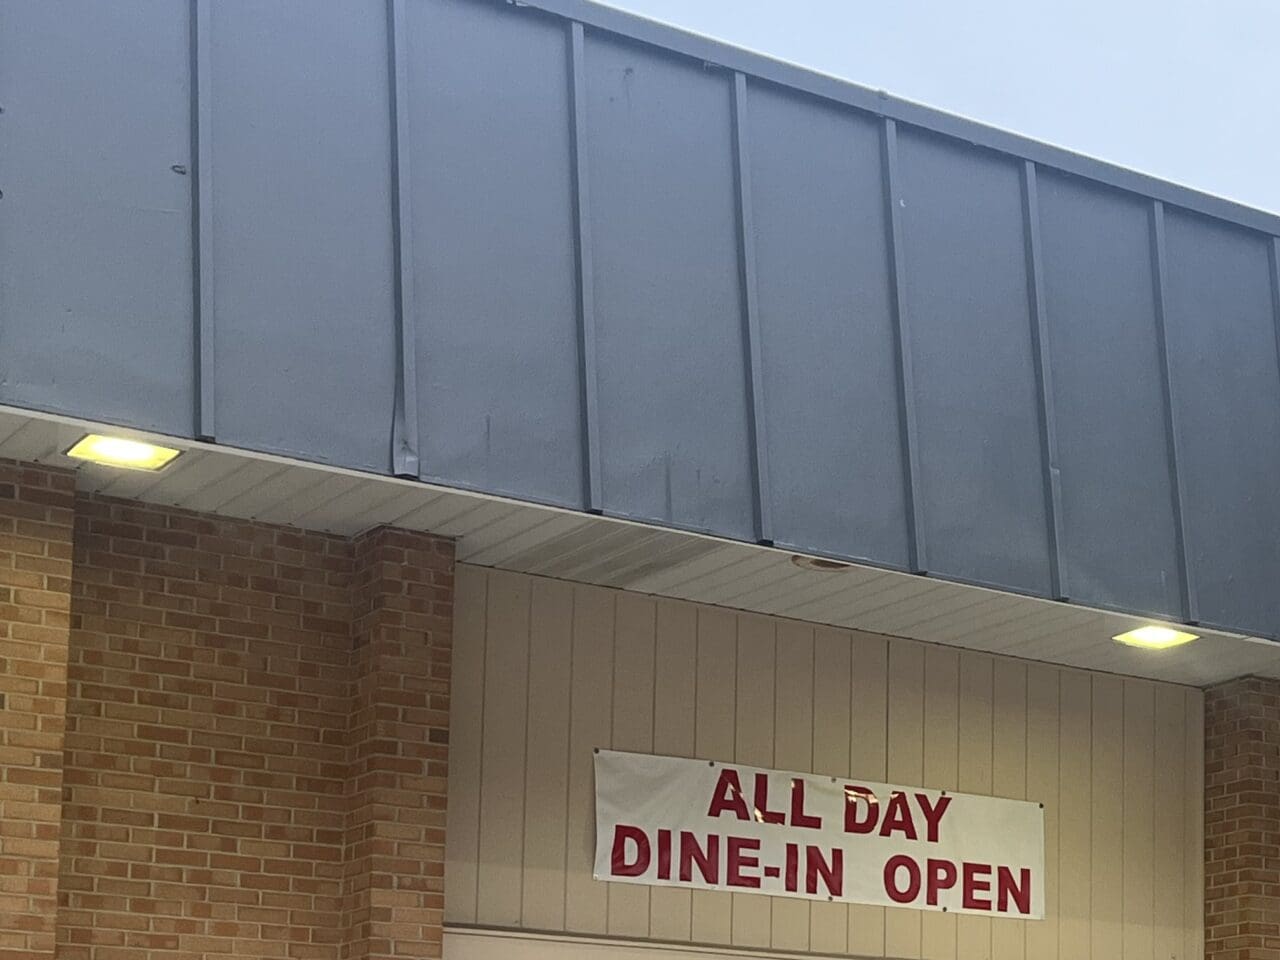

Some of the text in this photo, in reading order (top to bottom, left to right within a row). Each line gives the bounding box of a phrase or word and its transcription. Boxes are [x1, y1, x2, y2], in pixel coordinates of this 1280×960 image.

[708, 768, 952, 843] ALL DAY
[610, 824, 1031, 915] DINE-IN OPEN
